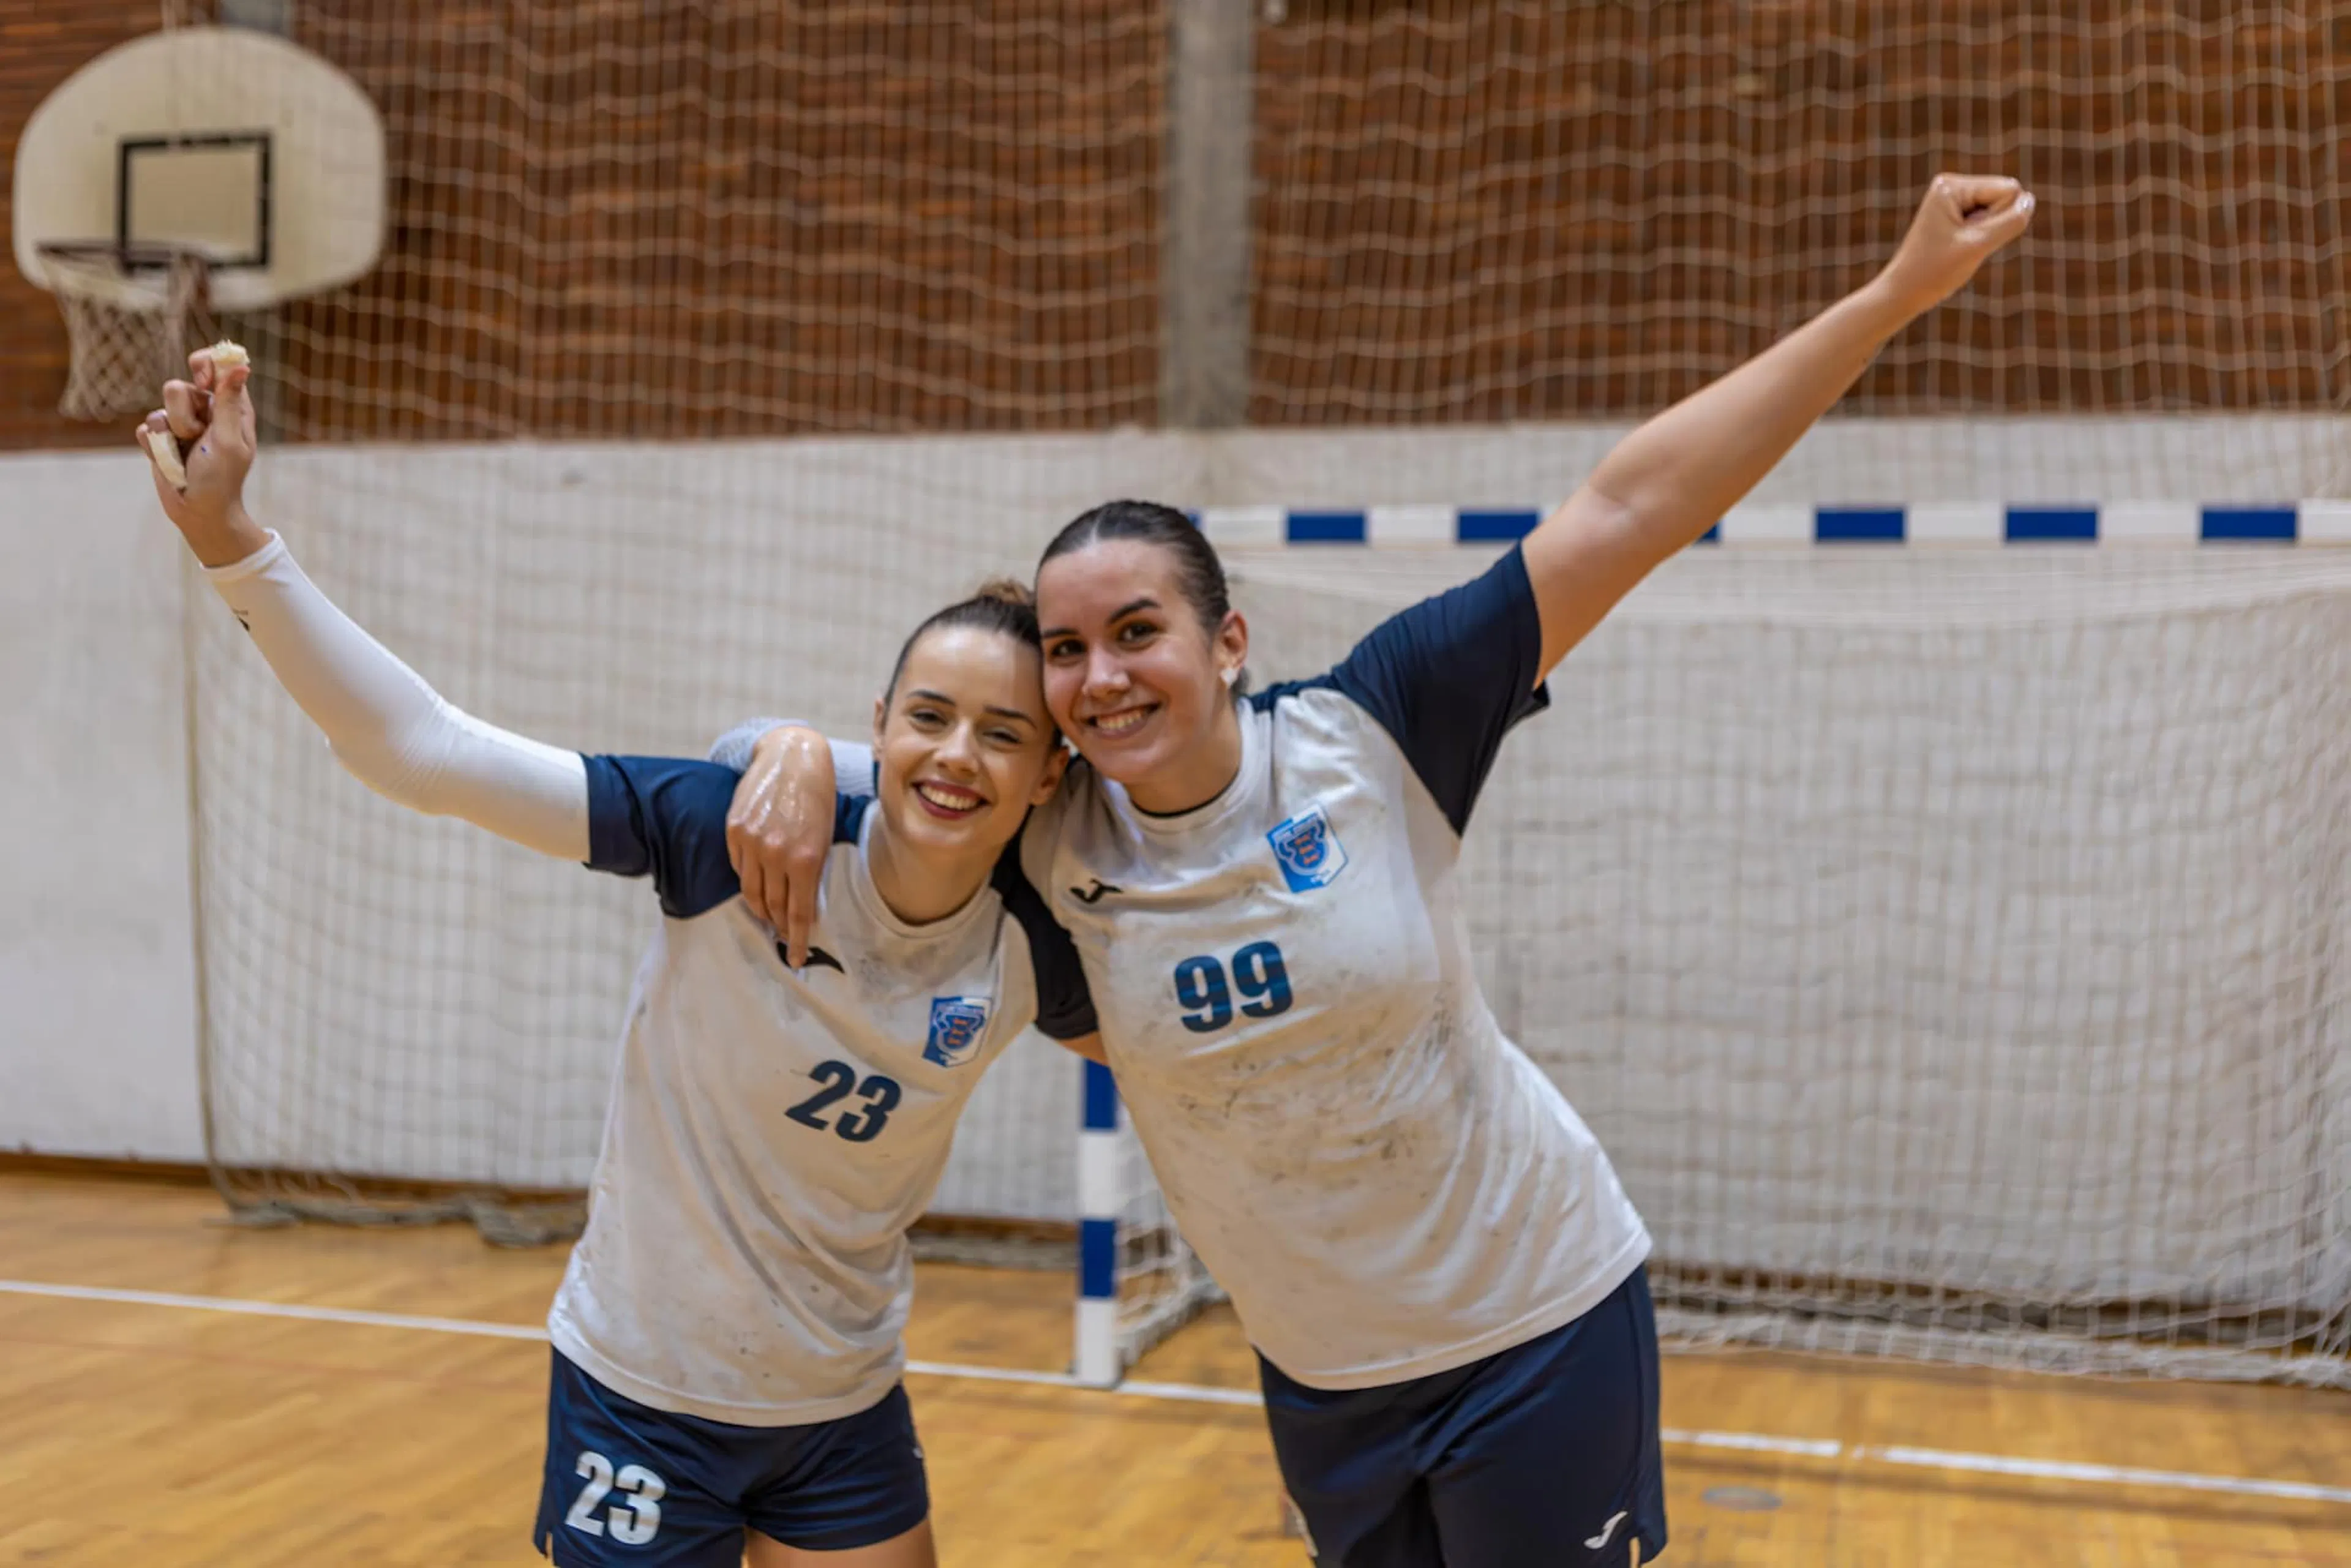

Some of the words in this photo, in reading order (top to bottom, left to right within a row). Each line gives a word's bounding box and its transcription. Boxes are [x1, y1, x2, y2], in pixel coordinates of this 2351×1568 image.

[1174, 940, 1293, 1032] 99
[784, 1060, 901, 1142] 23
[564, 1450, 666, 1545] 23
